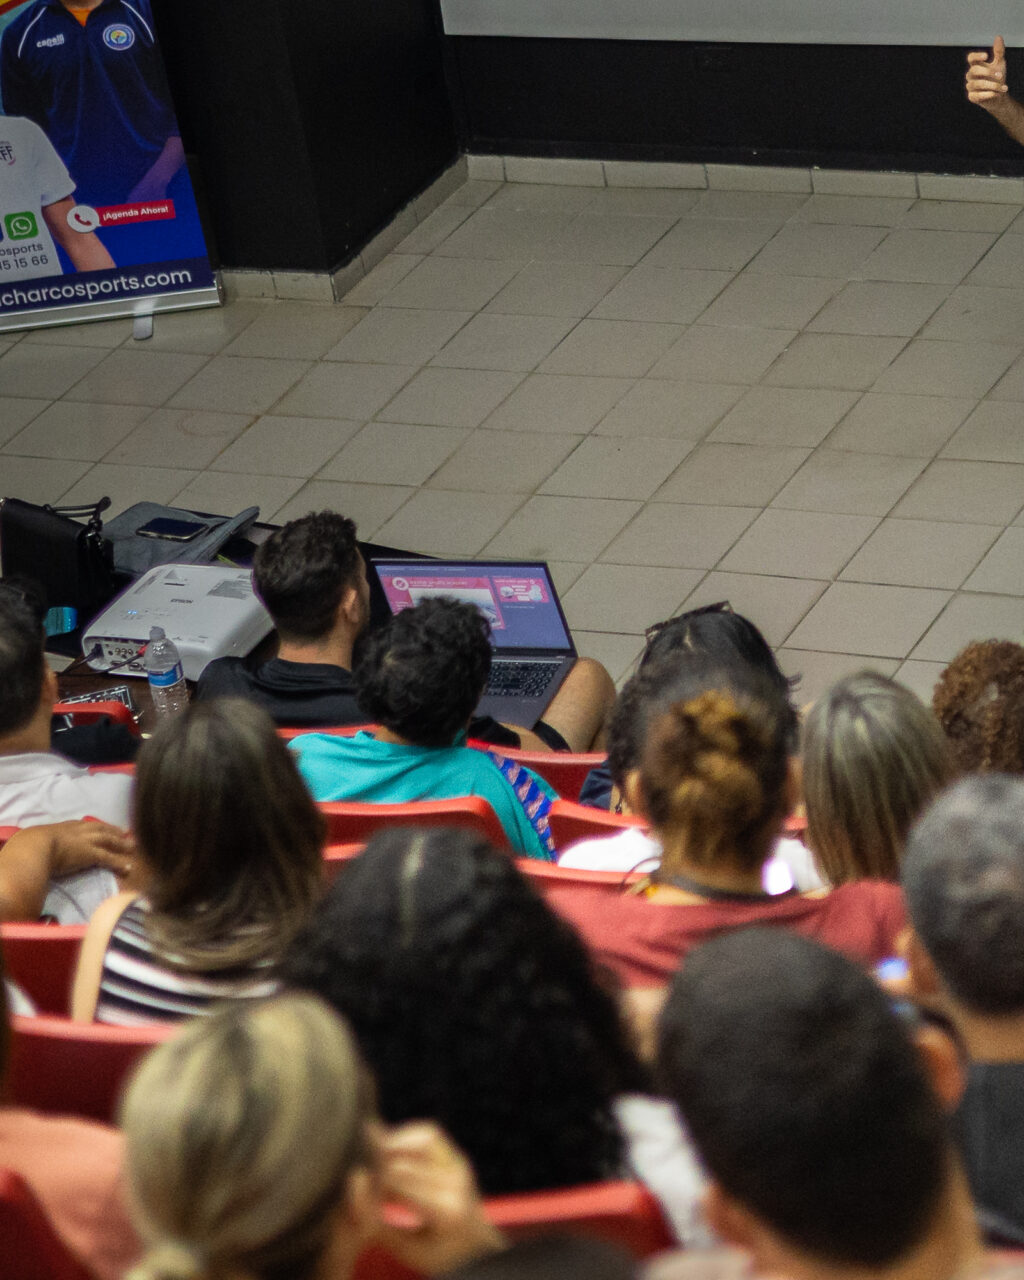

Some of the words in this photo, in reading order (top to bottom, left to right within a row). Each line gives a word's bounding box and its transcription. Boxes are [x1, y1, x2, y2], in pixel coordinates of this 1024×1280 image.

[103, 209, 139, 221] ¡Agenda
[140, 205, 169, 216] Ahora!
[14, 258, 28, 269] 15
[31, 254, 49, 266] 66
[0, 269, 192, 307] charcosports.com
